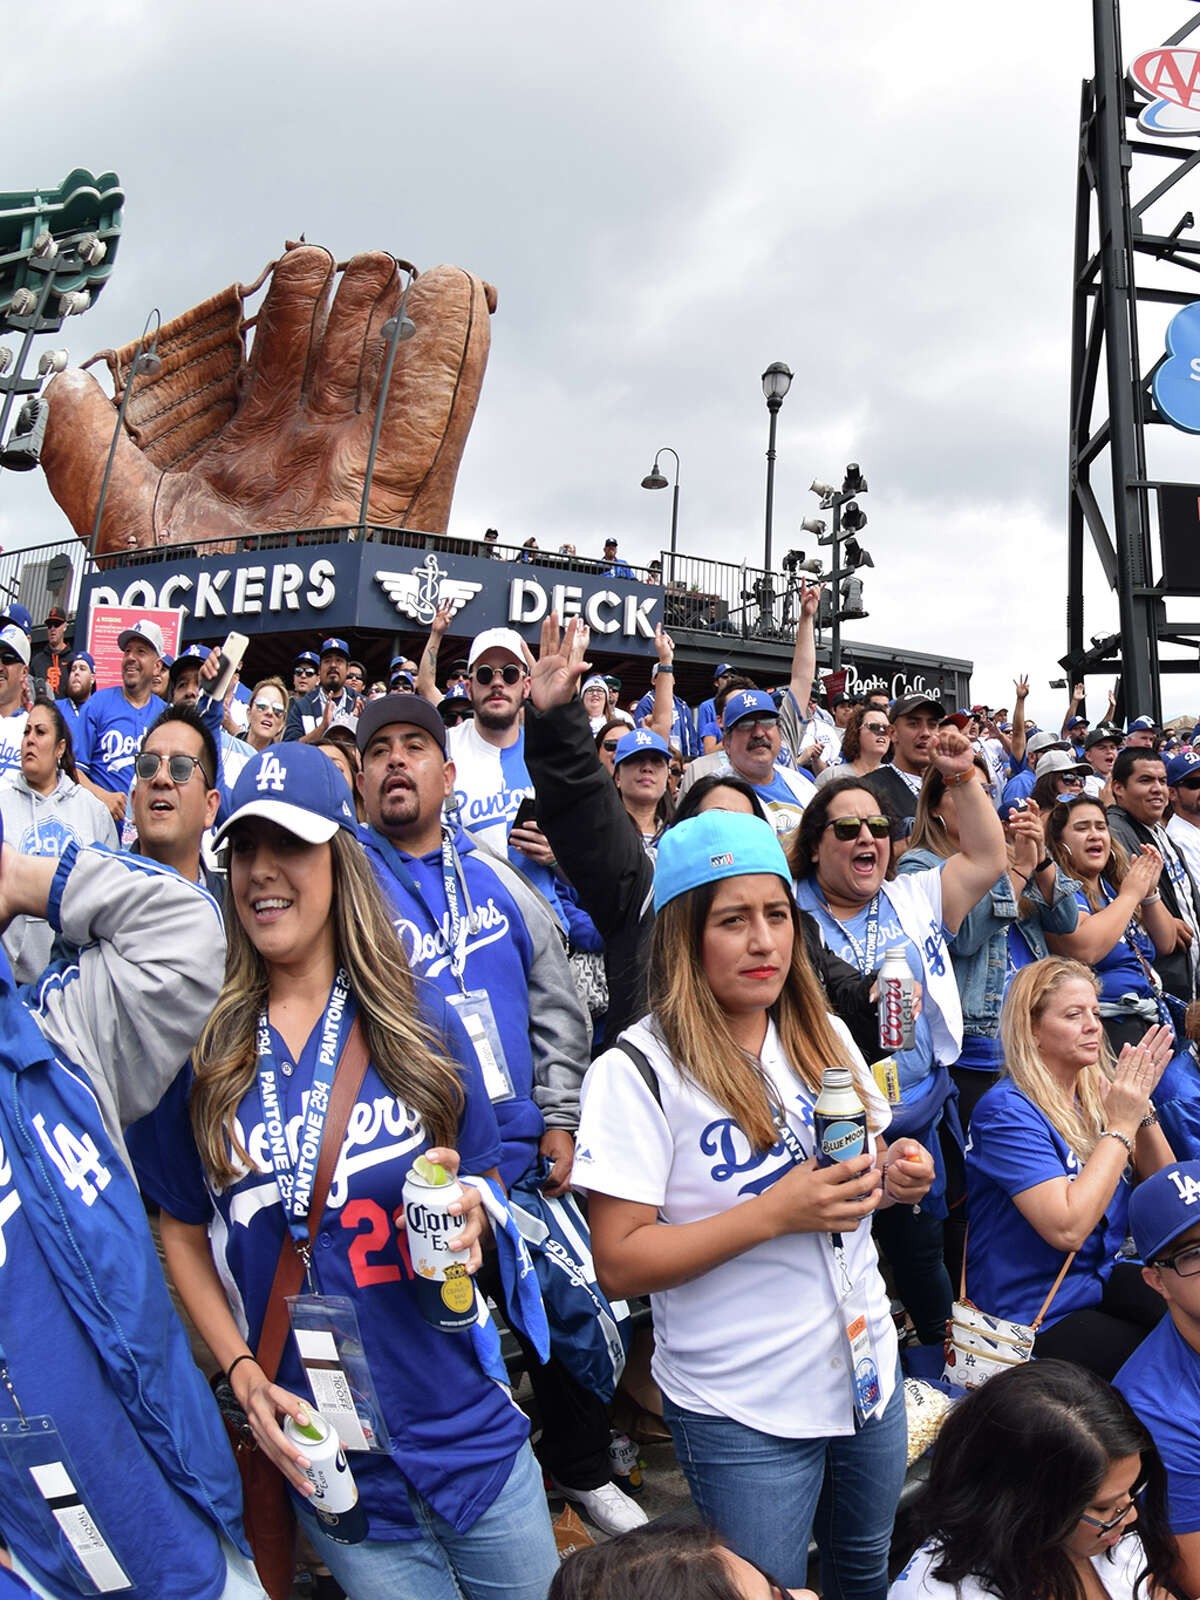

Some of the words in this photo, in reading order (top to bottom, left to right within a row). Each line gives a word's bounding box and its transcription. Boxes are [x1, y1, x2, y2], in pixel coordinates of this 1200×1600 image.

[508, 577, 659, 638] DECK
[841, 663, 889, 697] Peet's
[892, 673, 941, 702] Coffee
[256, 752, 286, 791] LA
[320, 987, 348, 1066] PANTONE
[880, 977, 904, 1047] Coors
[903, 990, 914, 1035] LIGHT
[260, 1071, 290, 1175] PANTONE
[293, 1110, 325, 1218] PANTONE
[310, 1080, 331, 1115] 294
[773, 1116, 806, 1164] PANT
[822, 1137, 845, 1154] BLUE
[844, 1126, 866, 1145] MOON
[32, 1114, 112, 1207] LA
[340, 1199, 414, 1289] 2
[406, 1202, 467, 1239] Coro
